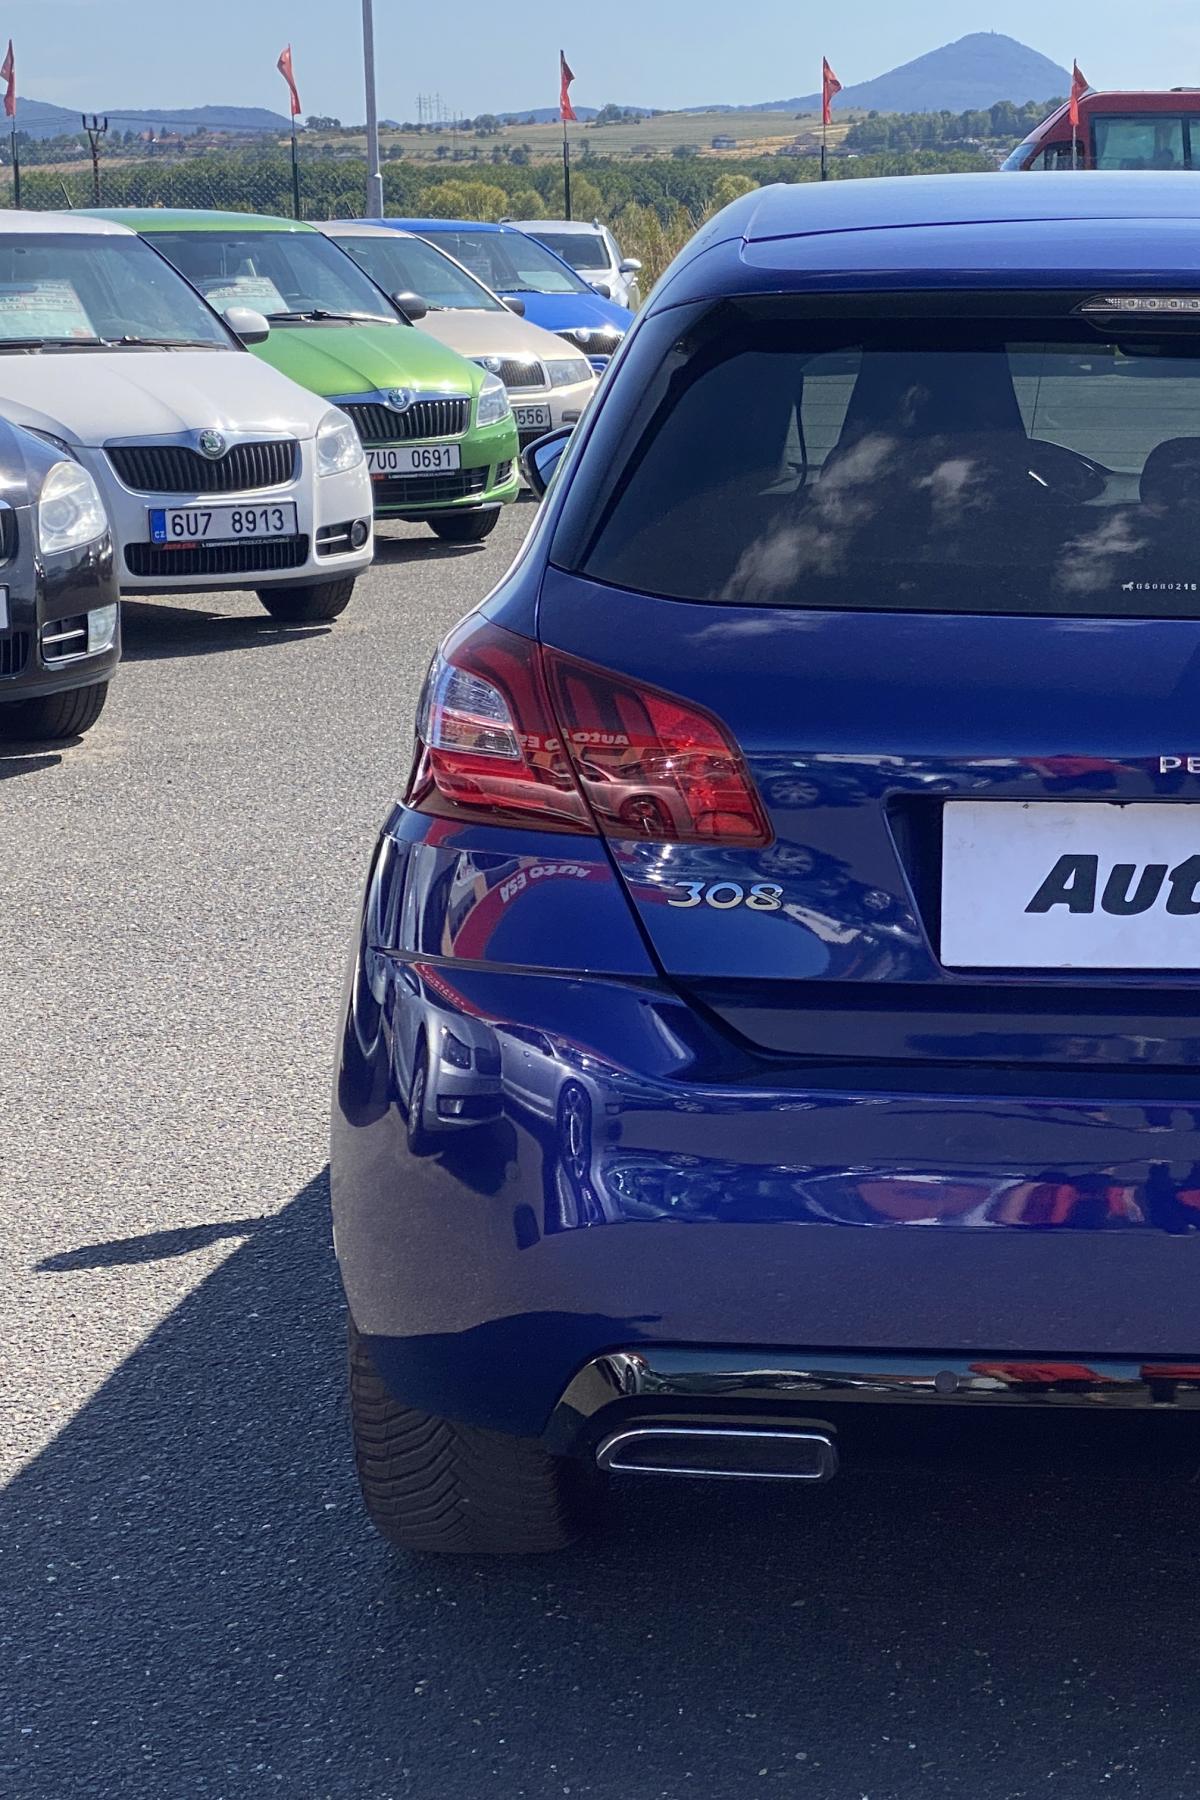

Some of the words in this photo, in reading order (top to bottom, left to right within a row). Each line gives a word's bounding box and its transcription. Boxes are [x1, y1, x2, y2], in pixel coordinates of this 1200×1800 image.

[411, 448, 451, 468] 0691
[154, 530, 166, 539] CZ
[171, 512, 212, 537] 6U7
[231, 508, 284, 533] 8913
[667, 881, 784, 911] 308
